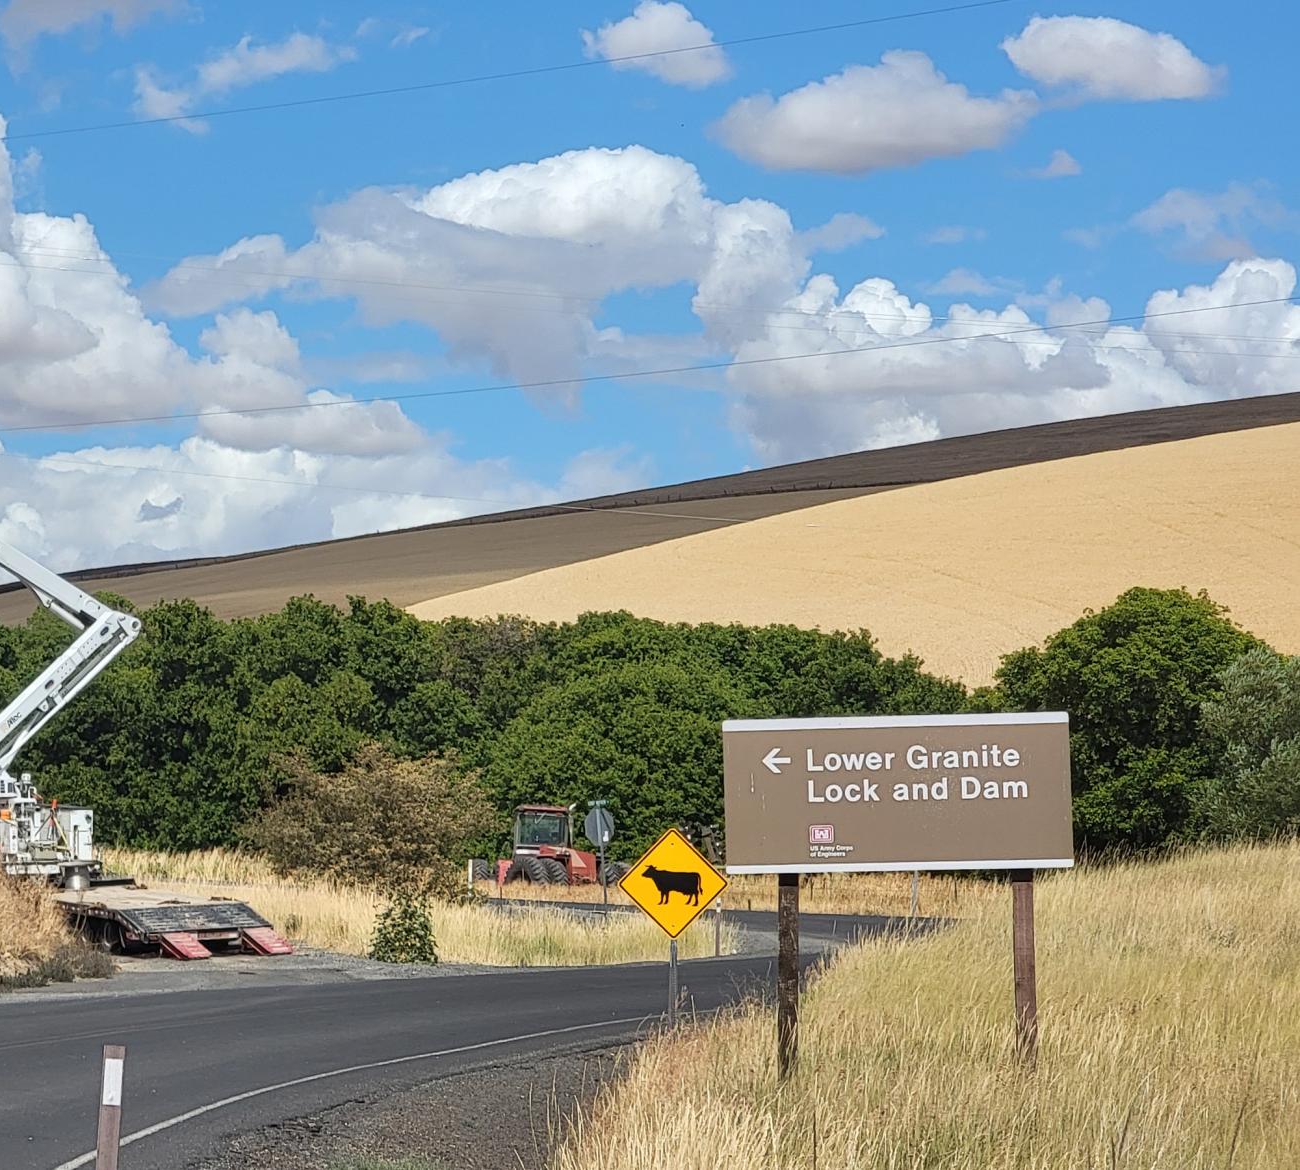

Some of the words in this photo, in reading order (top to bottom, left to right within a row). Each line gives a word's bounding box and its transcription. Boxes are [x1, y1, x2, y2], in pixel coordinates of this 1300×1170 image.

[806, 748, 895, 772] Lower
[906, 745, 1021, 770] Granite
[807, 778, 881, 803] Lock
[892, 777, 948, 801] and
[960, 776, 1029, 800] Dam
